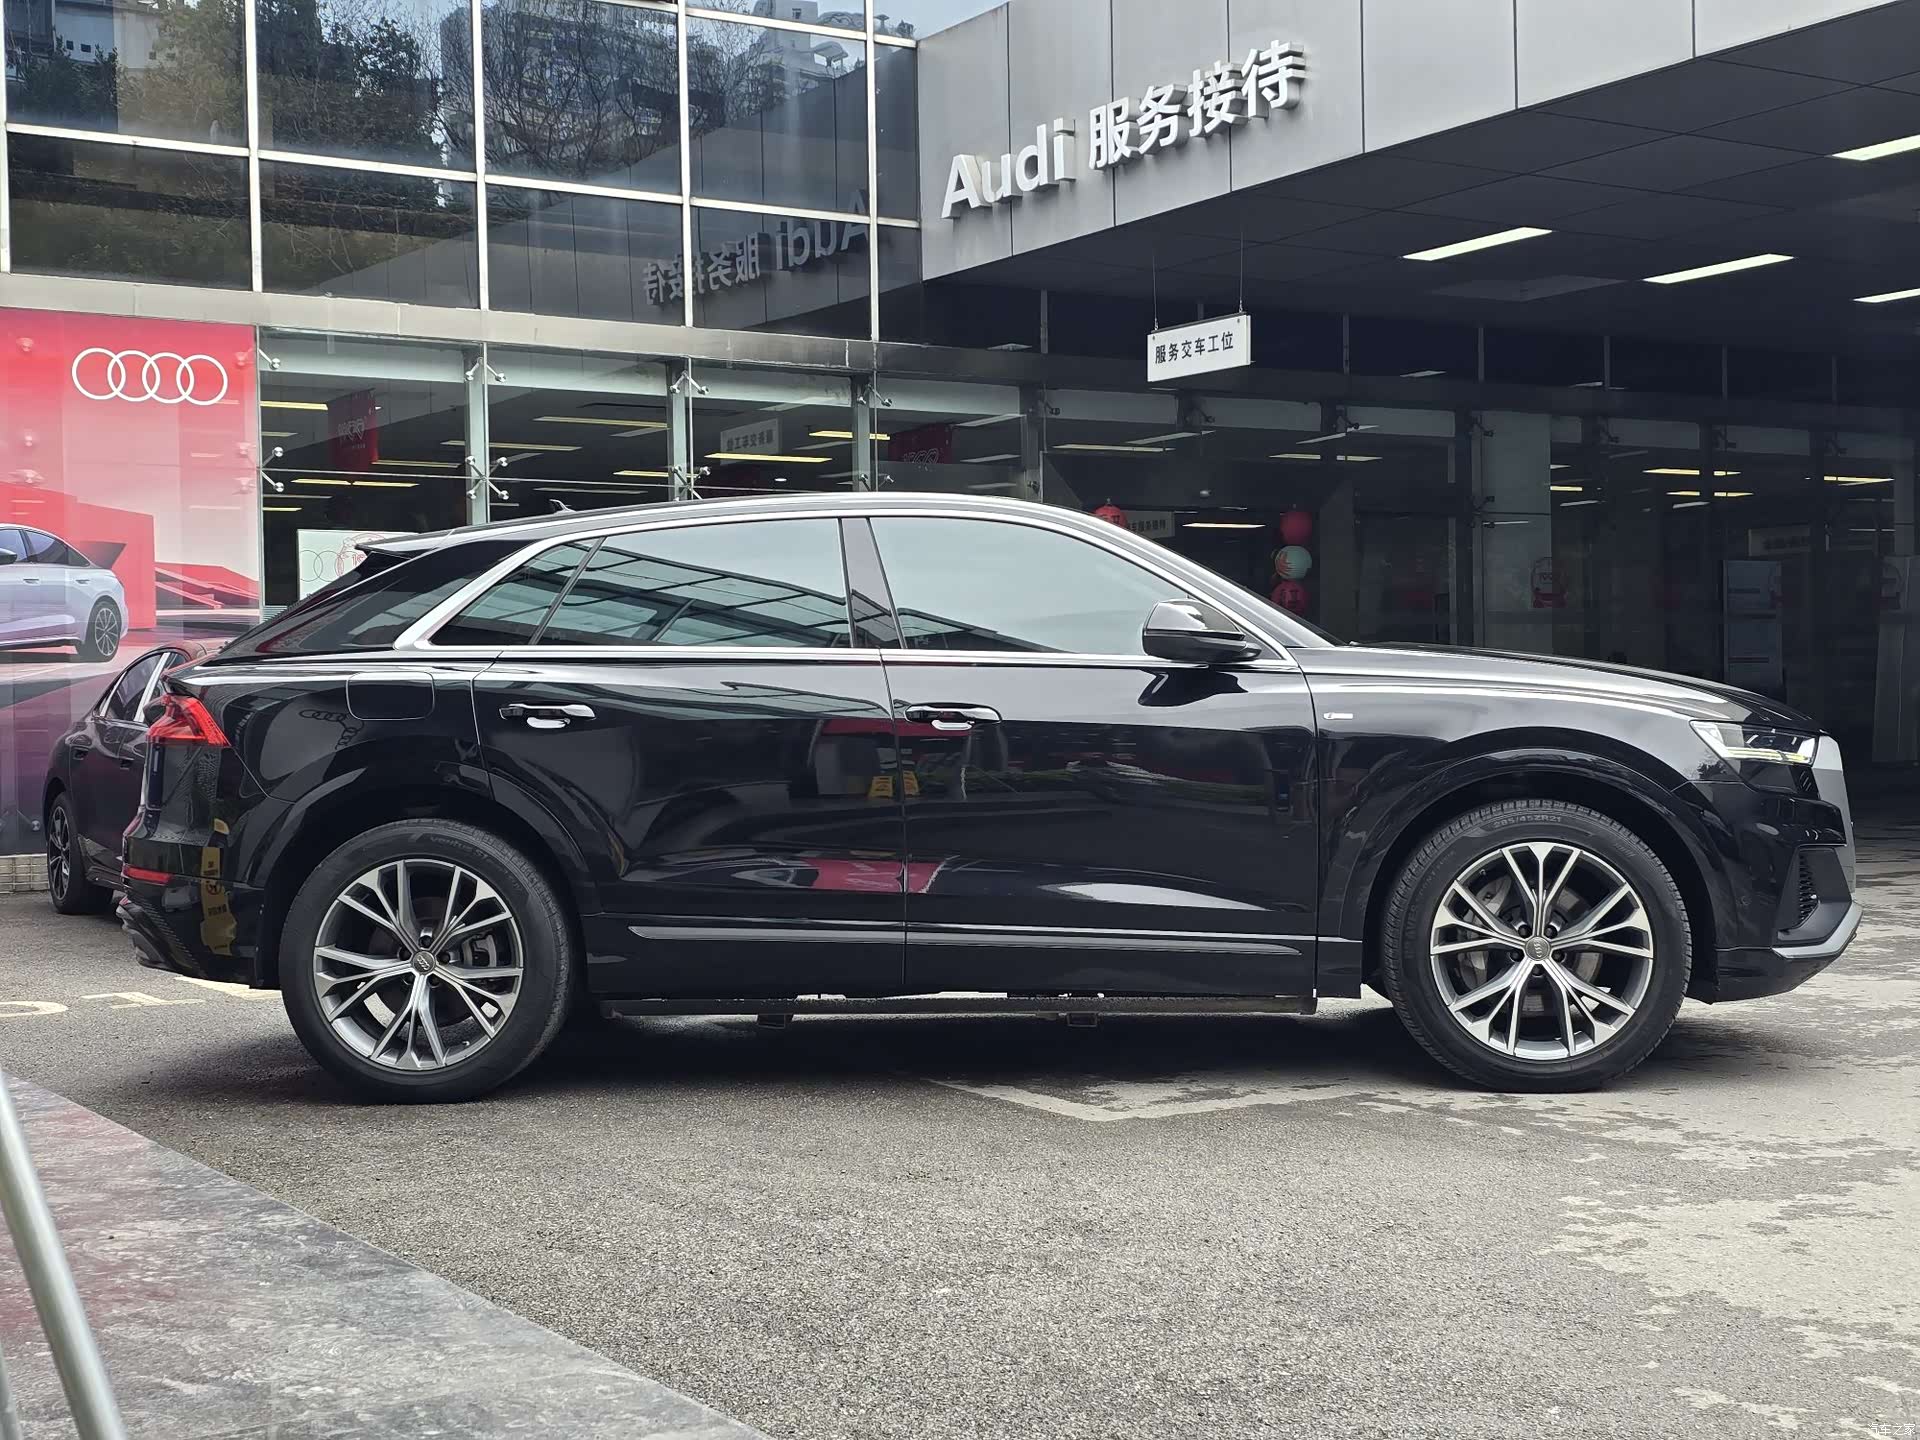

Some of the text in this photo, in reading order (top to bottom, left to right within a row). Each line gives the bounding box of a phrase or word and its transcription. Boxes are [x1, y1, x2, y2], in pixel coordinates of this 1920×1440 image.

[941, 39, 1304, 219] Audi 服务接待
[1155, 331, 1234, 364] 服务交车工位
